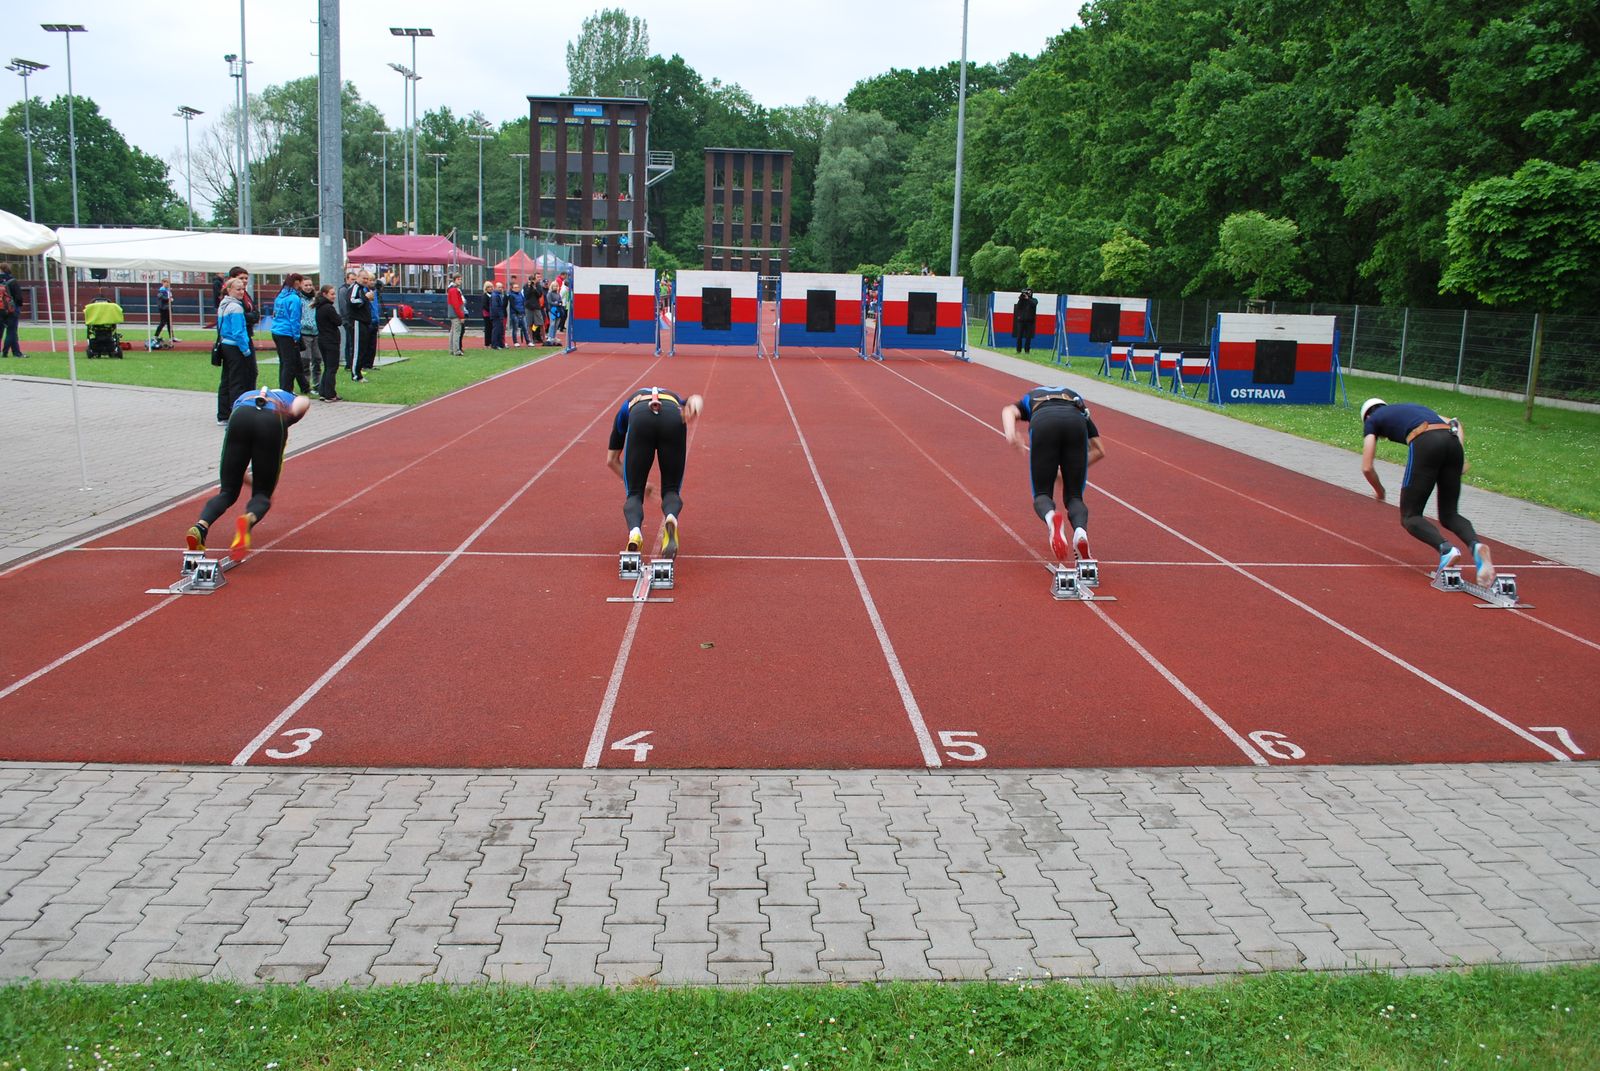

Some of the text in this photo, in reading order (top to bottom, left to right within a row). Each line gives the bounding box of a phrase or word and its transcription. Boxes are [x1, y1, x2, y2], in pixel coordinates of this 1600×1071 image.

[1230, 388, 1286, 399] OSTRAVA
[264, 727, 323, 760] 3
[610, 730, 654, 763] 4
[938, 731, 988, 761] 5
[1248, 730, 1306, 760] 6
[1528, 726, 1585, 755] 7
